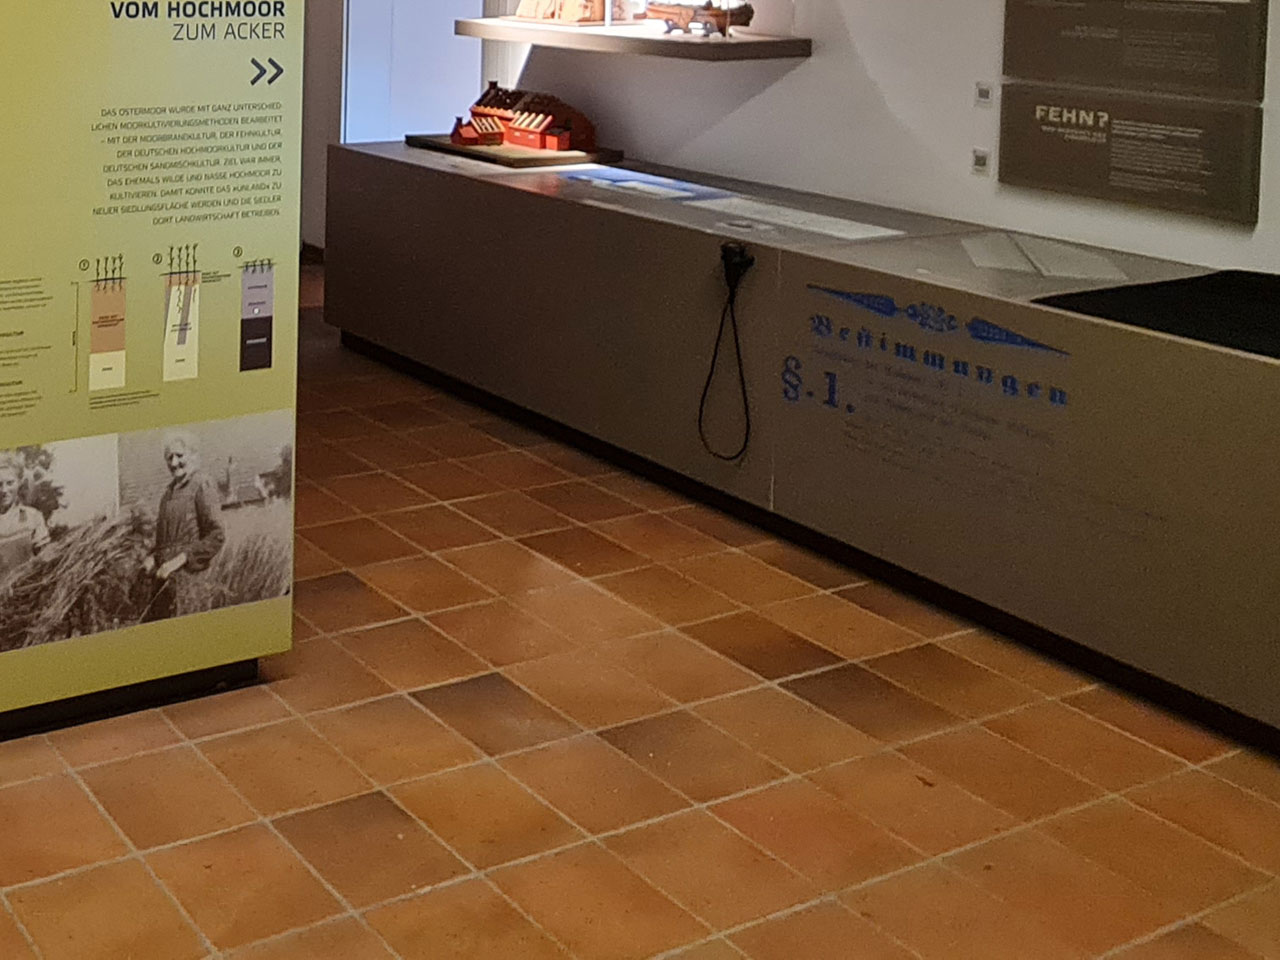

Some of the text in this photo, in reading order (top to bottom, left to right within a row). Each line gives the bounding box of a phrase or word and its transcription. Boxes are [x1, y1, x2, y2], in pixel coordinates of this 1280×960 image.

[110, 0, 286, 19] VOM HOCHMOOR
[172, 22, 286, 41] ZUM ACKER
[1035, 104, 1109, 128] FEHN?
